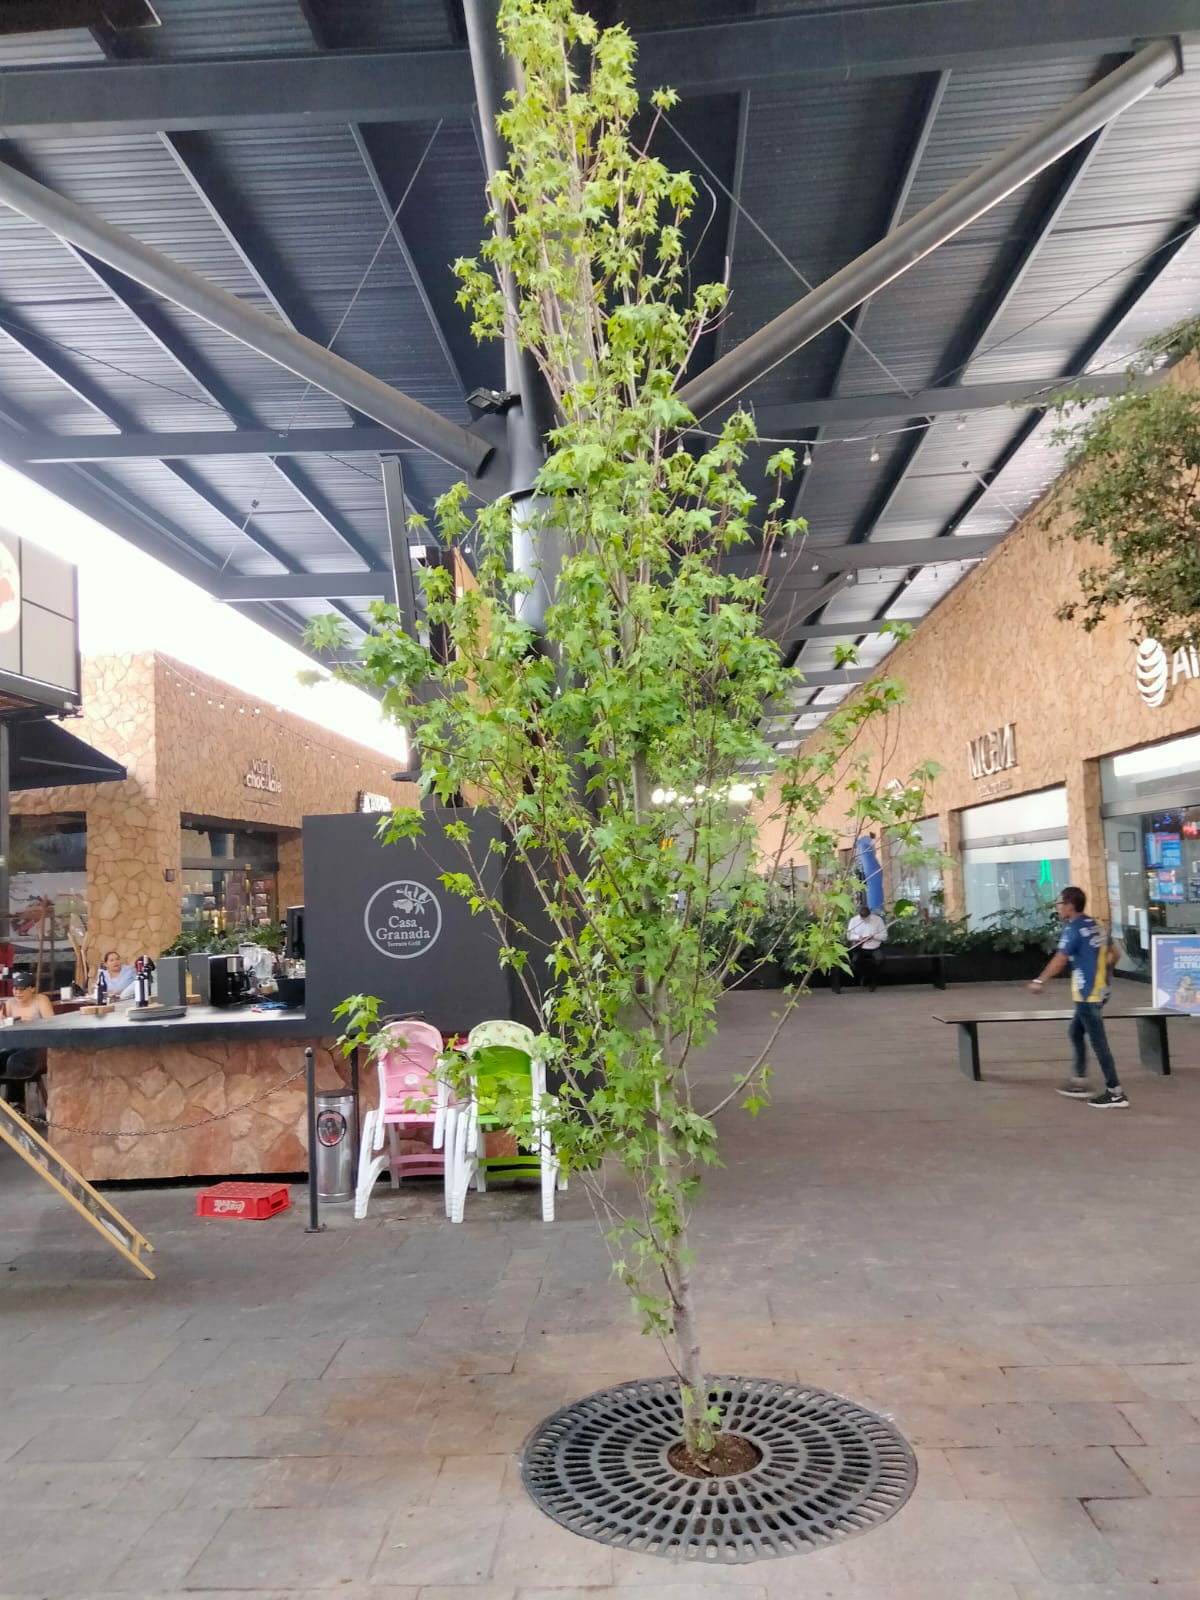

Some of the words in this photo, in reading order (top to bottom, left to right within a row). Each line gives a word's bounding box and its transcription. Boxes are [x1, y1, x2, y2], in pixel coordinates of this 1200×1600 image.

[966, 723, 1018, 780] MGM
[388, 915, 417, 928] Casa
[376, 927, 431, 940] Granada
